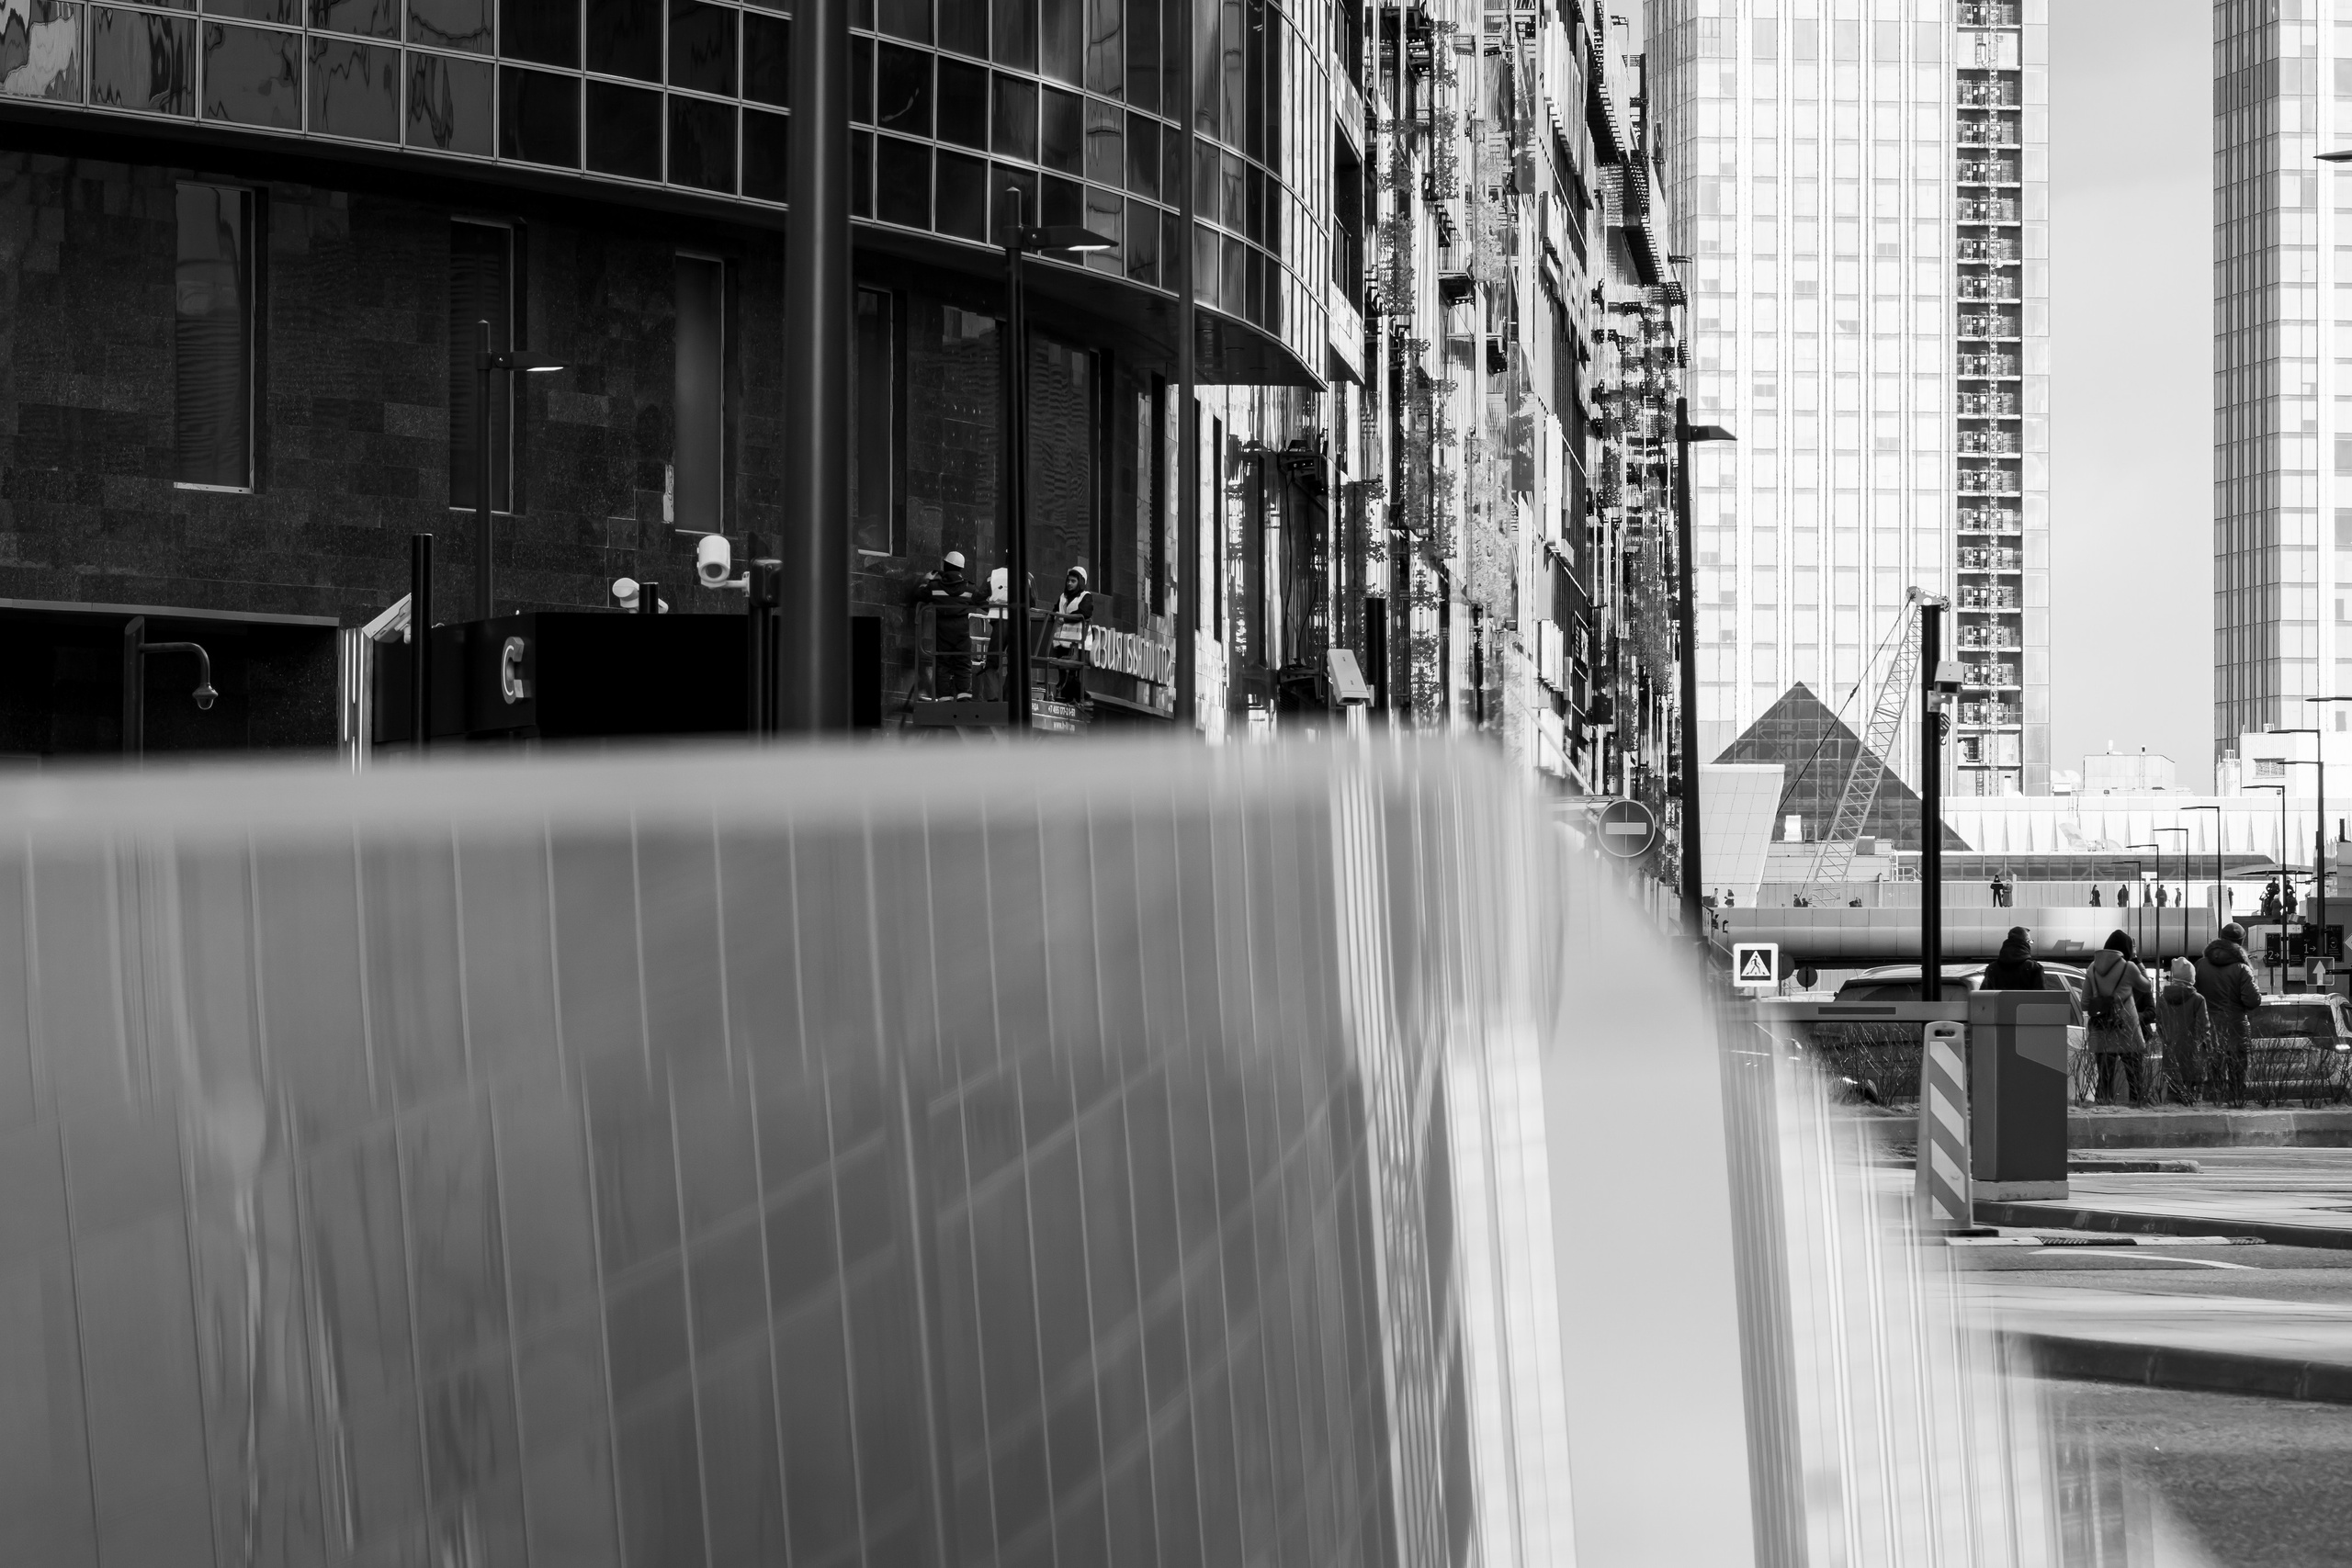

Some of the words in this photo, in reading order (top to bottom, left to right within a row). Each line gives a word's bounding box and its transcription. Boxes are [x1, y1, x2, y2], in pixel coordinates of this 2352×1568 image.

[1091, 625, 1123, 672] азия
[1124, 633, 1155, 682] бьюти
[1156, 643, 1171, 687] спа
[2303, 943, 2309, 953] 1
[2267, 950, 2274, 960] 2
